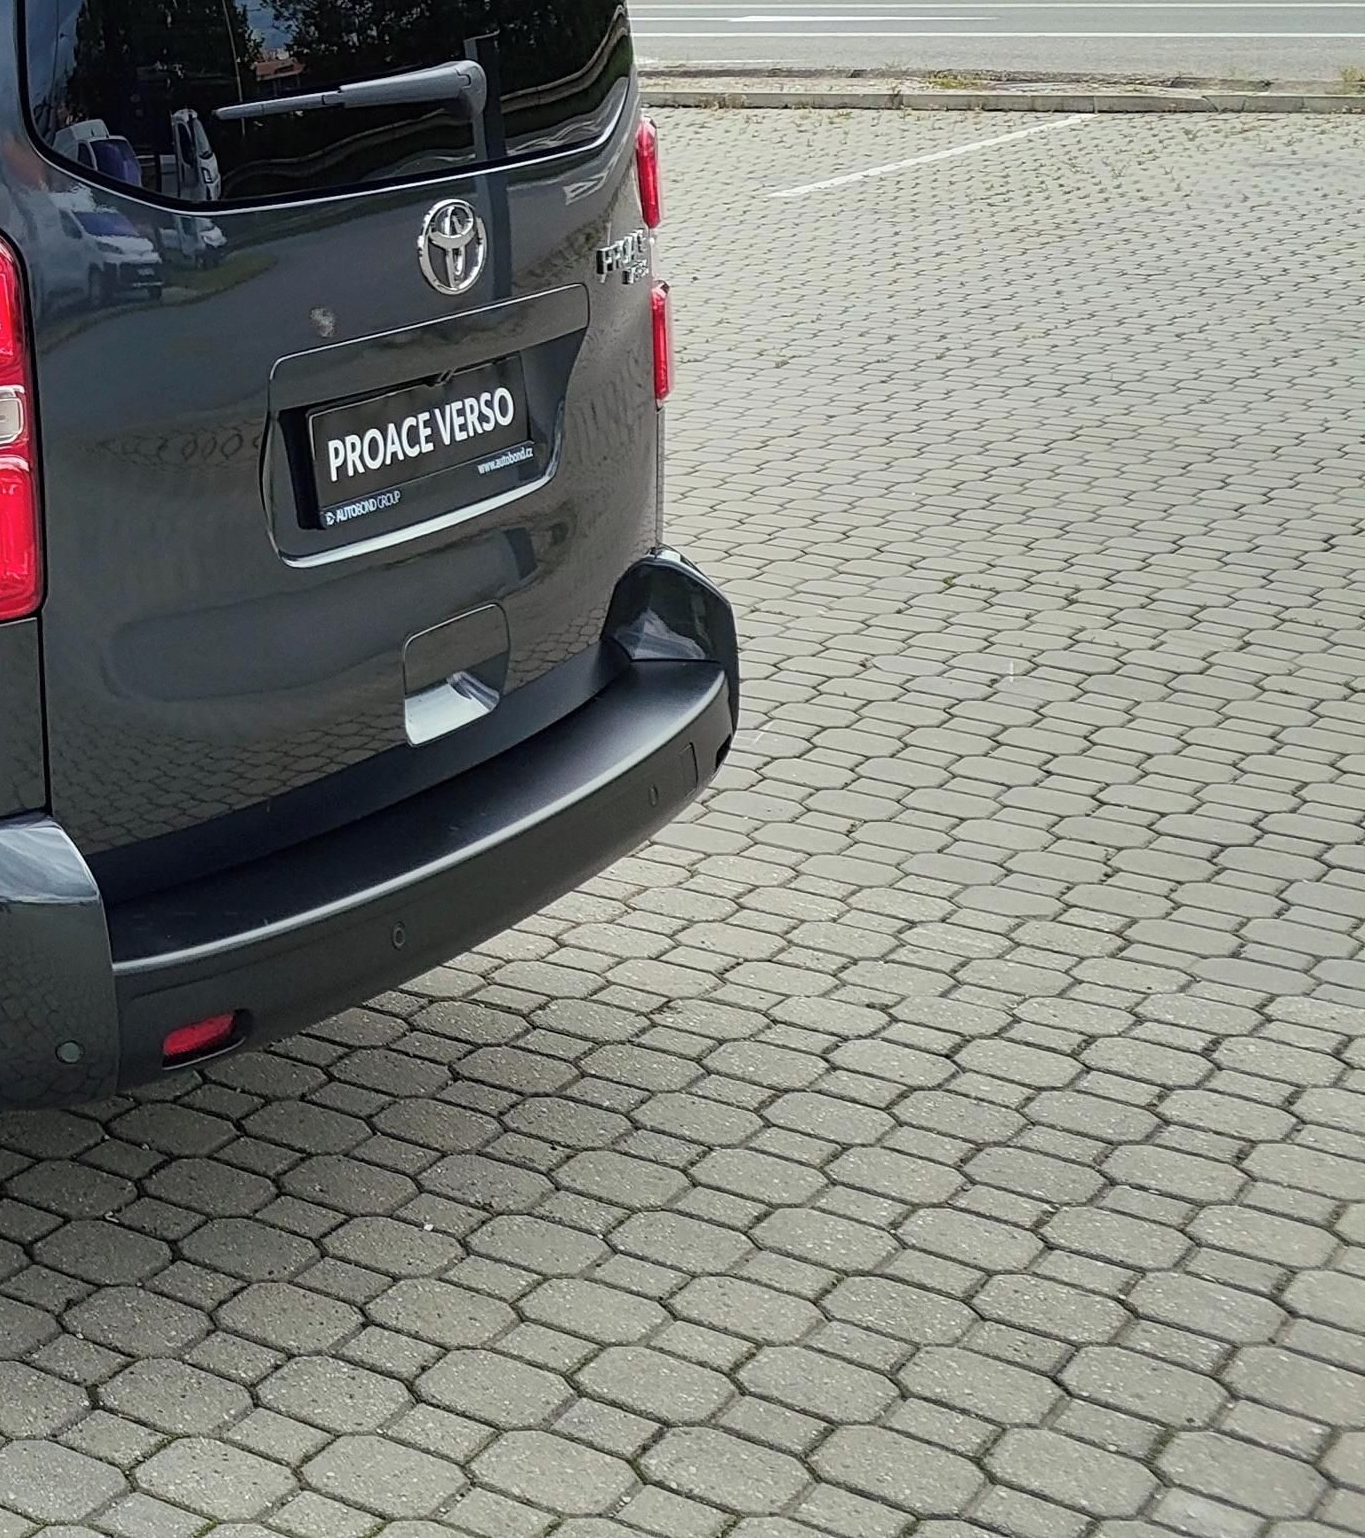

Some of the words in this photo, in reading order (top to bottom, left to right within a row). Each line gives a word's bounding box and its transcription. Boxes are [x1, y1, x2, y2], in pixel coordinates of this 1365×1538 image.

[327, 412, 435, 482] PROACE
[434, 387, 515, 446] VERSO
[476, 445, 534, 476] www.autobond.cz
[335, 497, 378, 524] AUTOBOND
[376, 490, 402, 510] GROUP
